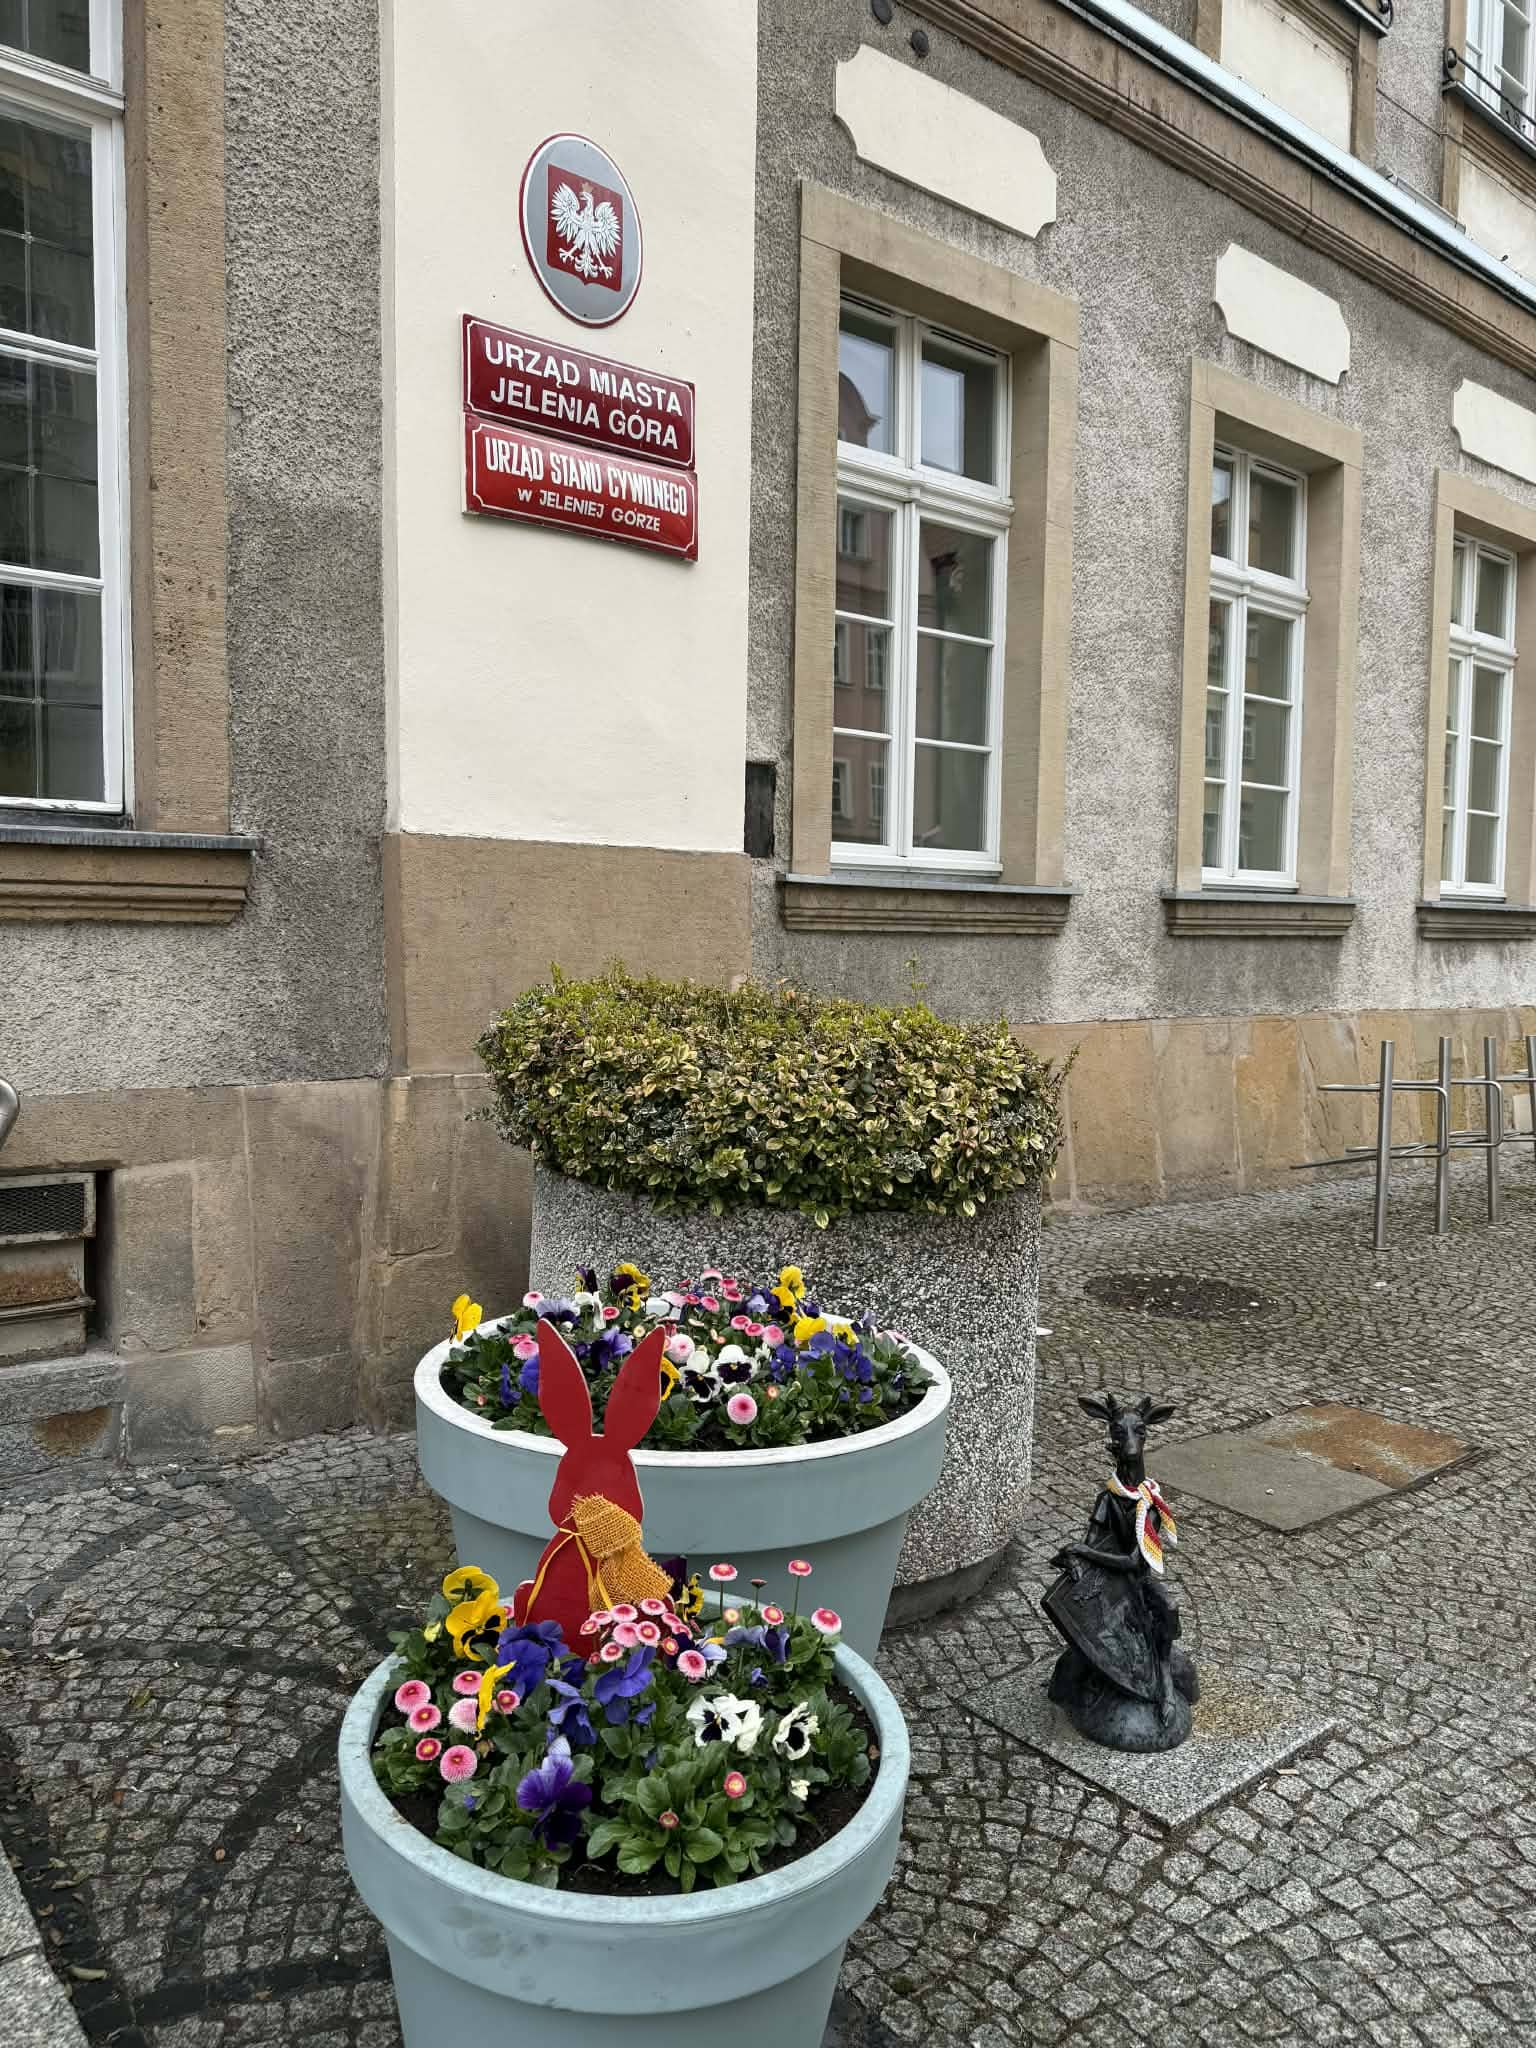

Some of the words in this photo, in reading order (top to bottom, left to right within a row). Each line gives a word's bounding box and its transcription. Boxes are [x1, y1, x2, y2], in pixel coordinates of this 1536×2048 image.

[485, 336, 580, 388] URZĄD
[590, 368, 682, 416] MIASTA
[491, 378, 600, 428] JELENIA
[608, 409, 679, 449] GÓRA
[485, 436, 543, 482] URZĄD
[550, 452, 602, 493] STANU
[607, 466, 687, 516] CYWILNEGO
[539, 490, 604, 518] JELENIEJ
[611, 507, 661, 532] GÓRZE
